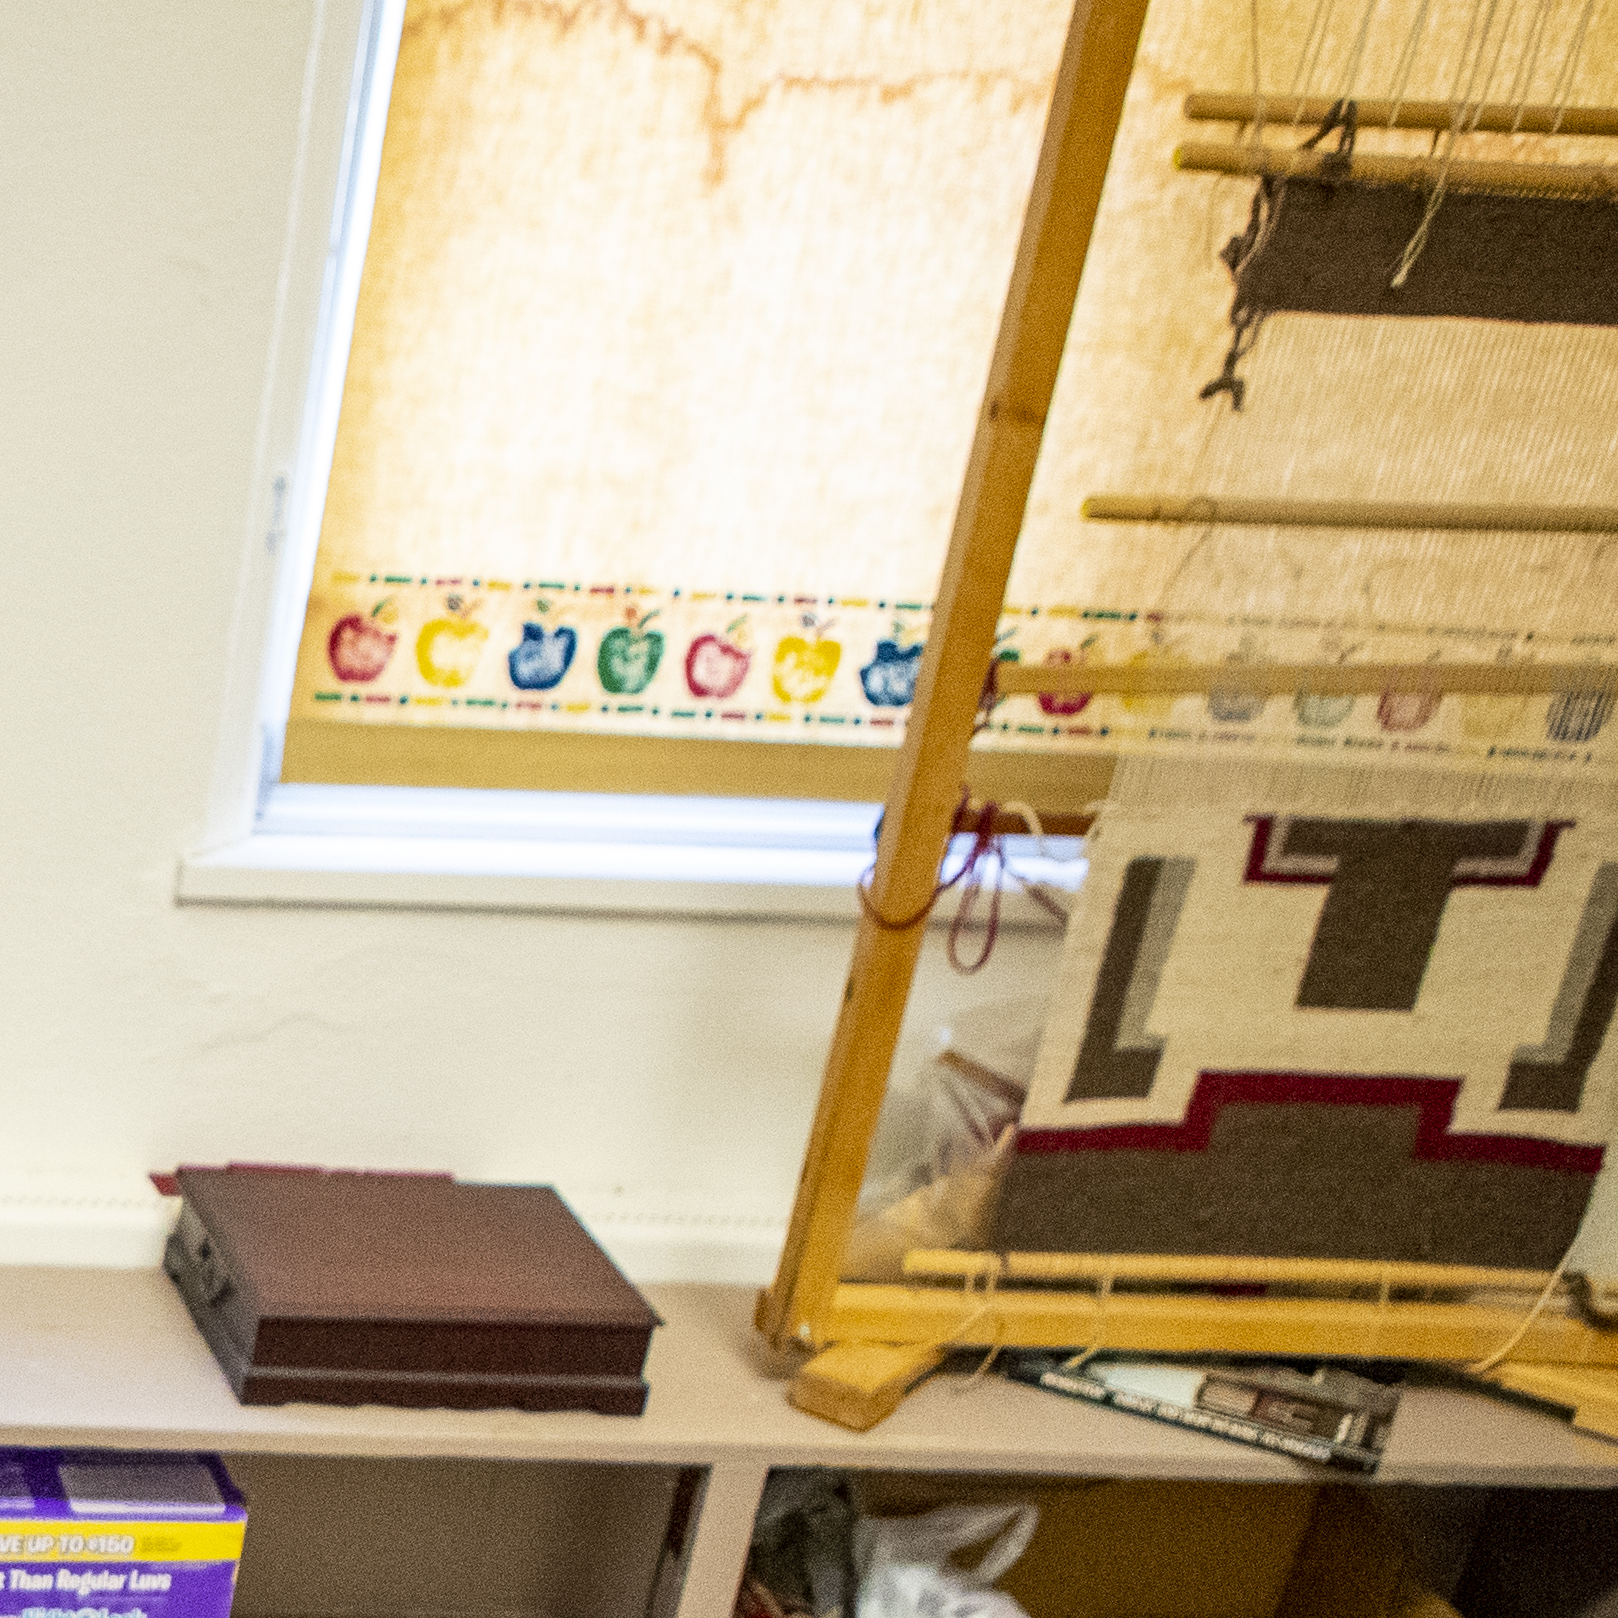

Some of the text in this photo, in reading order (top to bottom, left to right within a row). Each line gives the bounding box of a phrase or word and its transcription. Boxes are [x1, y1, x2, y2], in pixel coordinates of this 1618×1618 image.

[27, 1534, 55, 1554] UP
[58, 1535, 84, 1554] TO
[10, 1568, 54, 1591] Than
[57, 1568, 127, 1596] Regular
